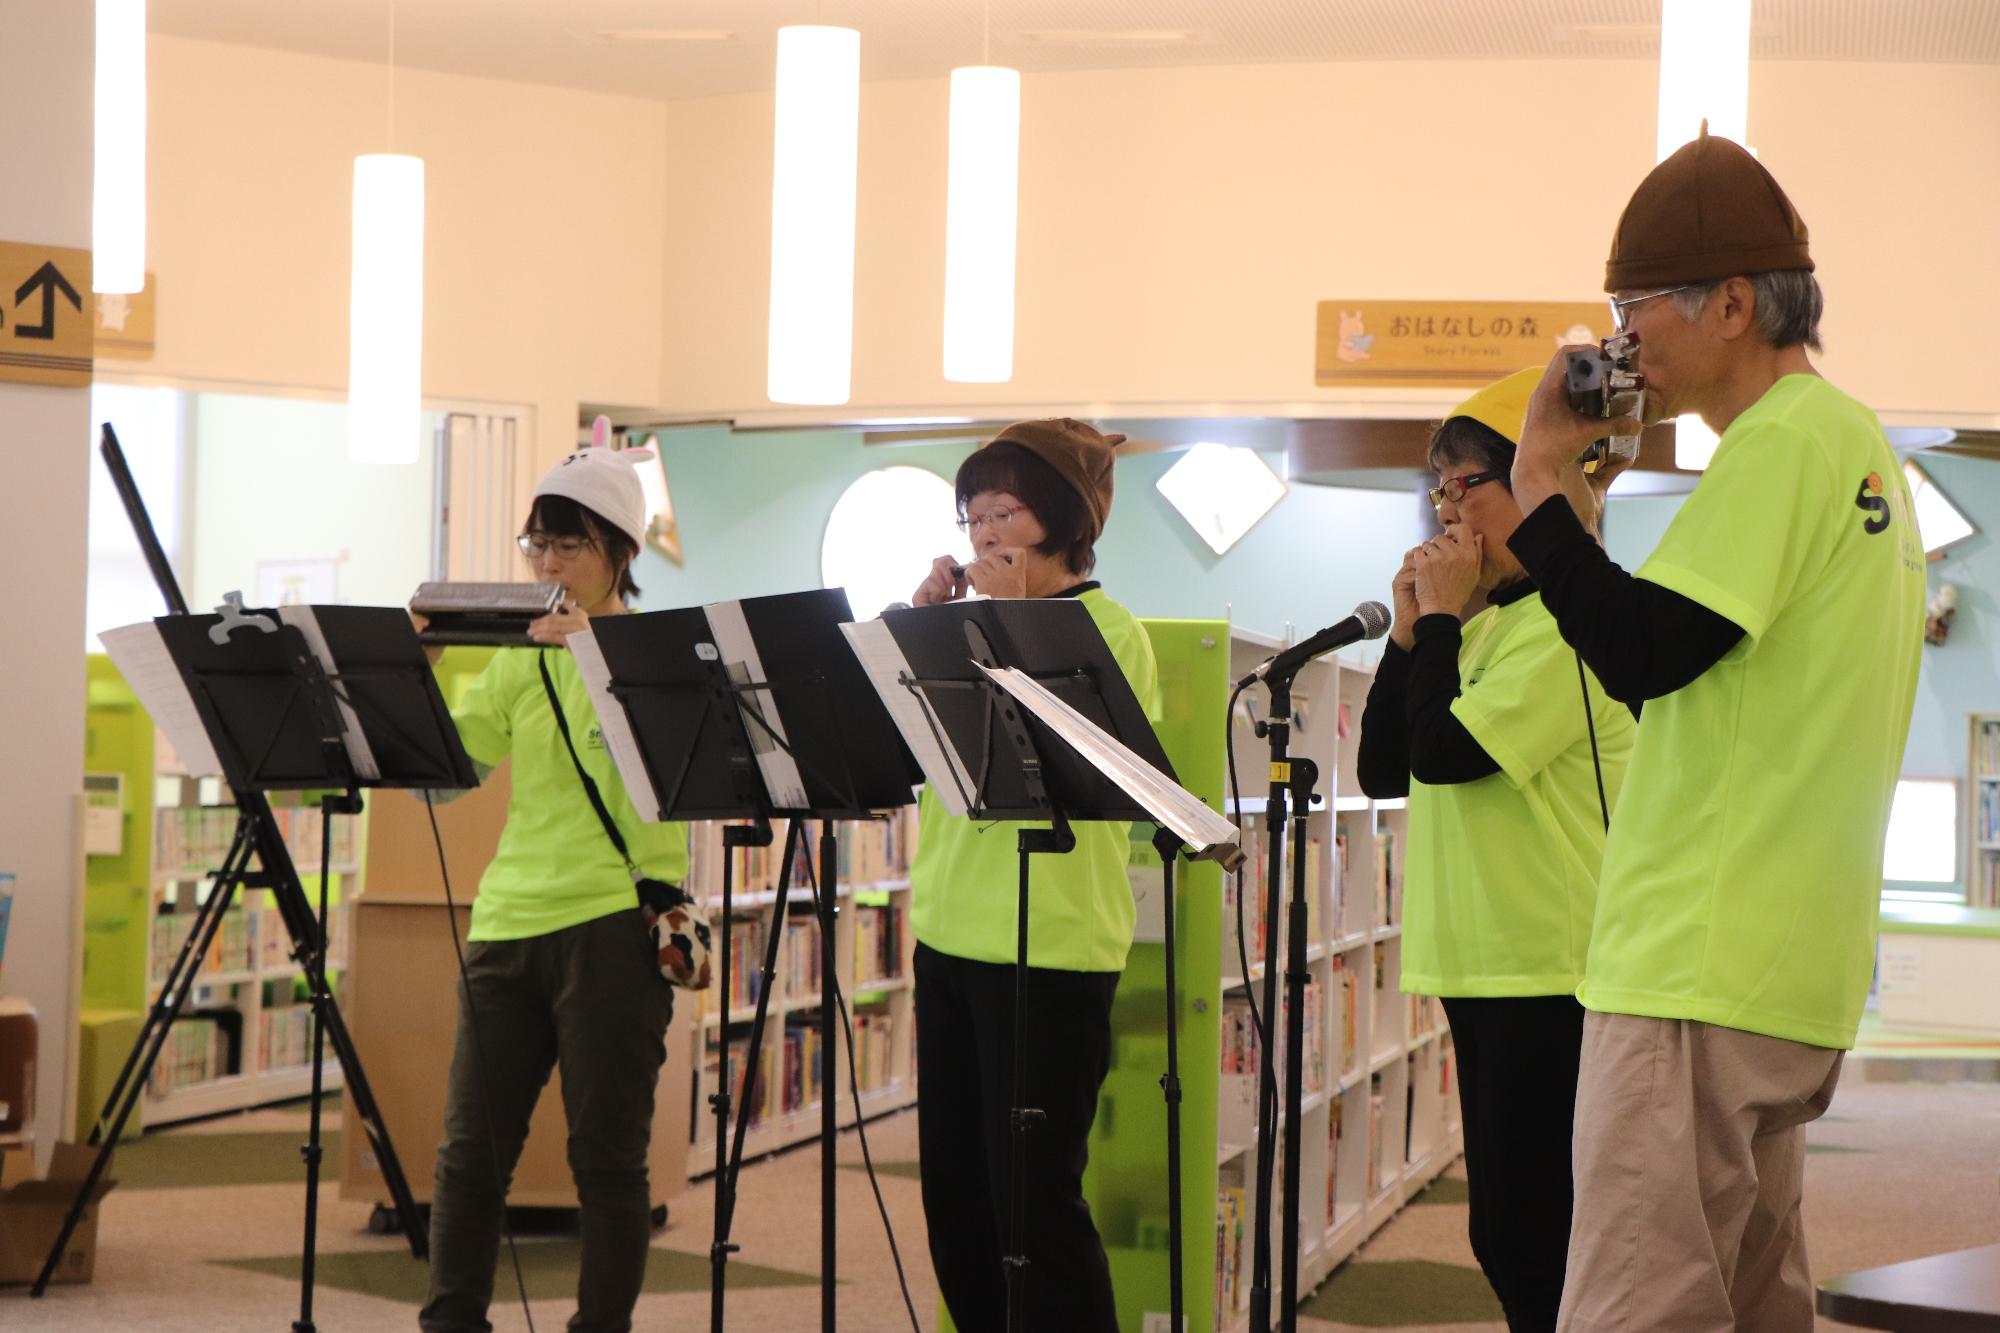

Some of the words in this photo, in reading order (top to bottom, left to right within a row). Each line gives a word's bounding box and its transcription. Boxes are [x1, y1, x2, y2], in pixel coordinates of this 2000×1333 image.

[1390, 316, 1538, 338] おはなしの森
